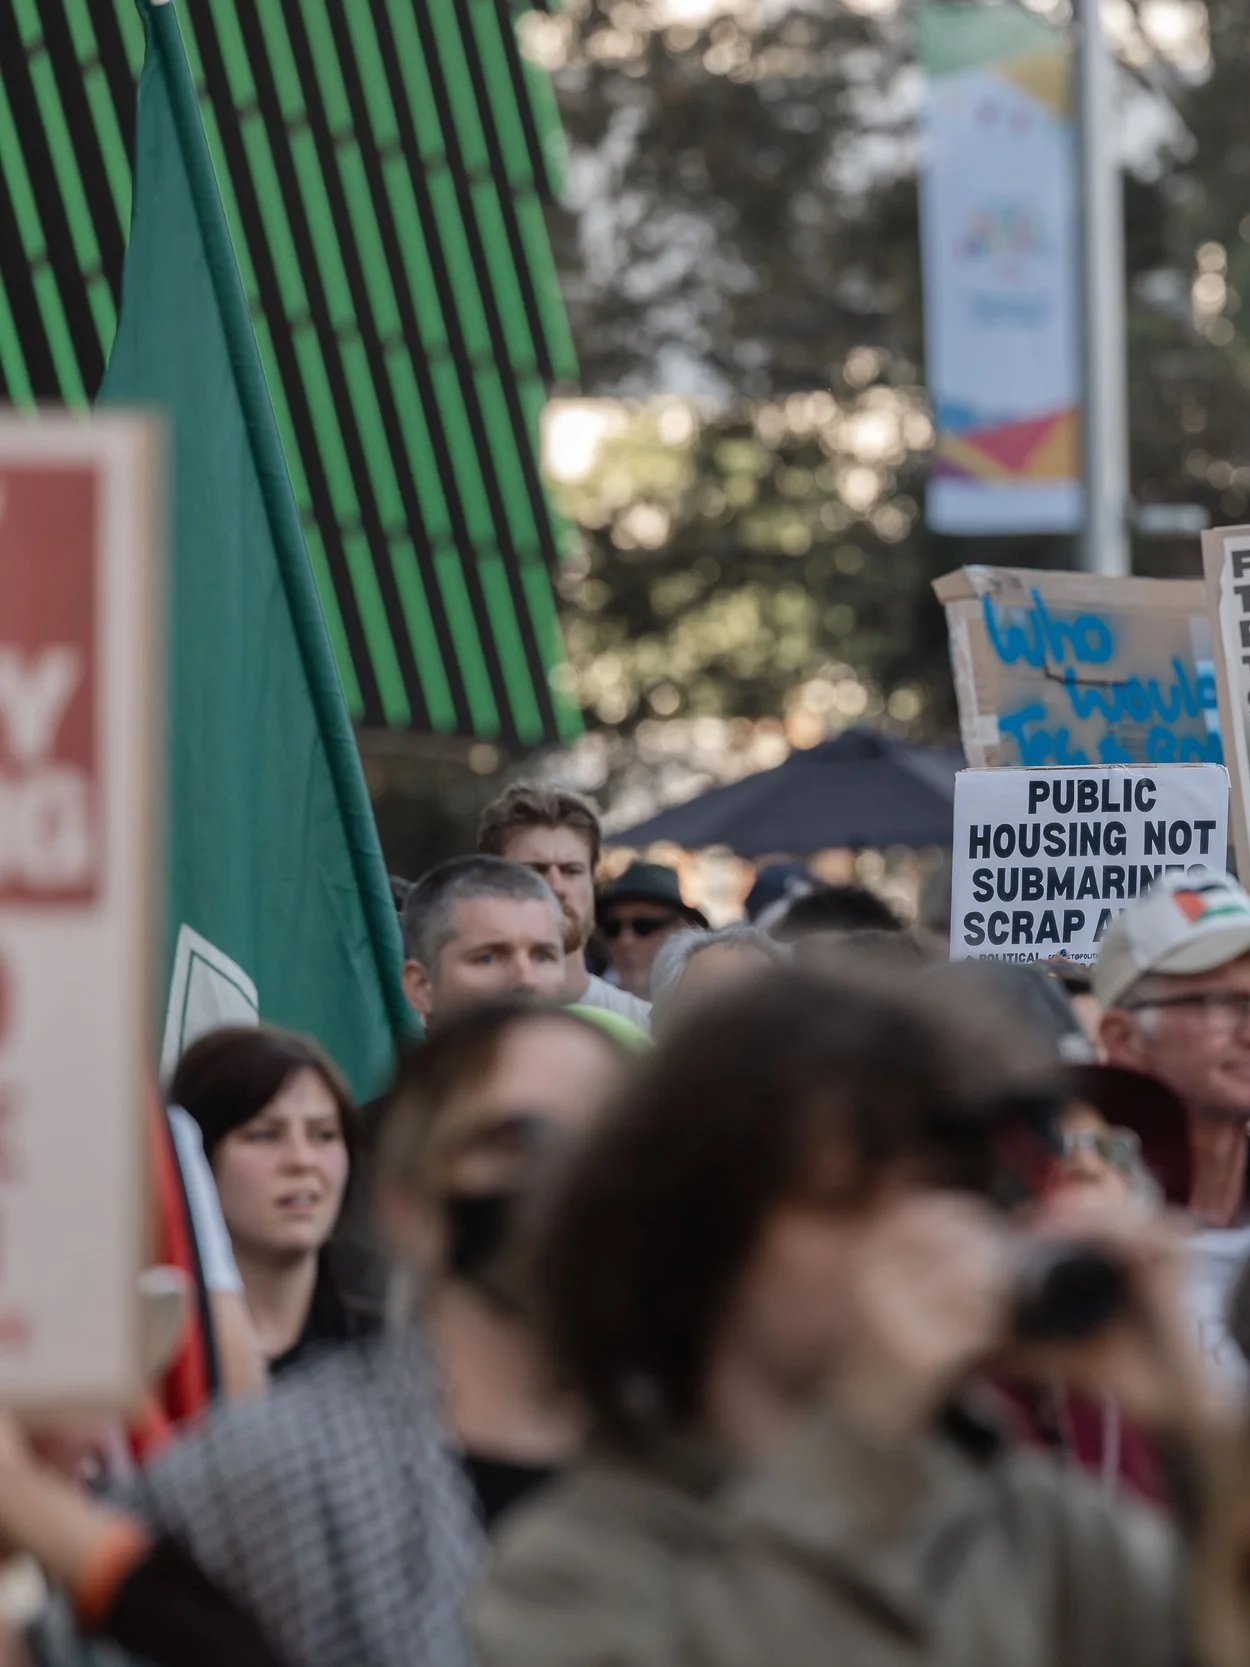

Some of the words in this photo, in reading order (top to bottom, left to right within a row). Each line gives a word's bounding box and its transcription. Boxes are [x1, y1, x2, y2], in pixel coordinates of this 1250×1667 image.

[982, 588, 1113, 666] Who
[1027, 778, 1157, 815] PUBLIC
[968, 822, 1127, 860] HOUSING
[1143, 820, 1216, 856] NOT
[972, 864, 1208, 903] SUBMARIN
[963, 909, 1085, 946] SCRAP
